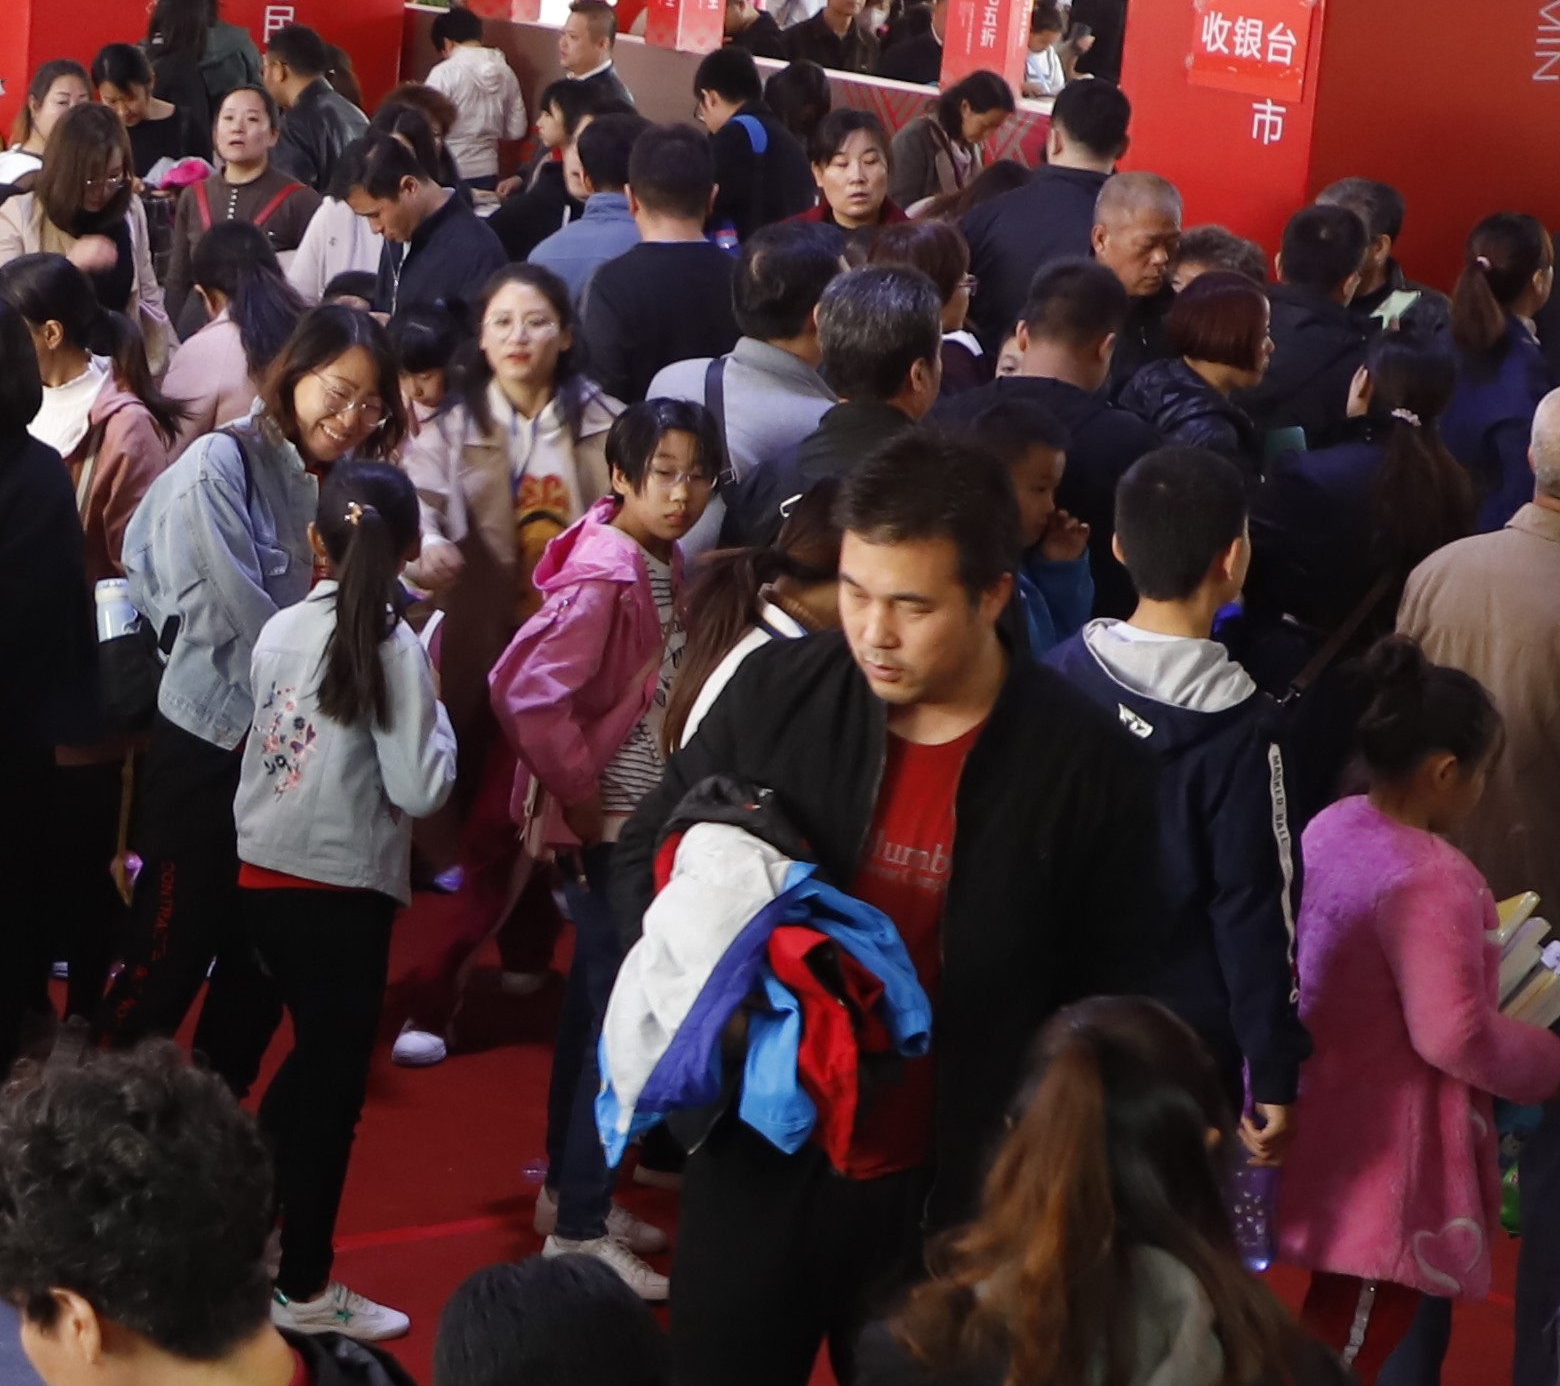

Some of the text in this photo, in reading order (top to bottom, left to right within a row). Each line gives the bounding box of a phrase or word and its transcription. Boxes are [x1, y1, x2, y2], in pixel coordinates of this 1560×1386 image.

[1200, 10, 1298, 66] 收银台
[1271, 754, 1284, 806] MASKED
